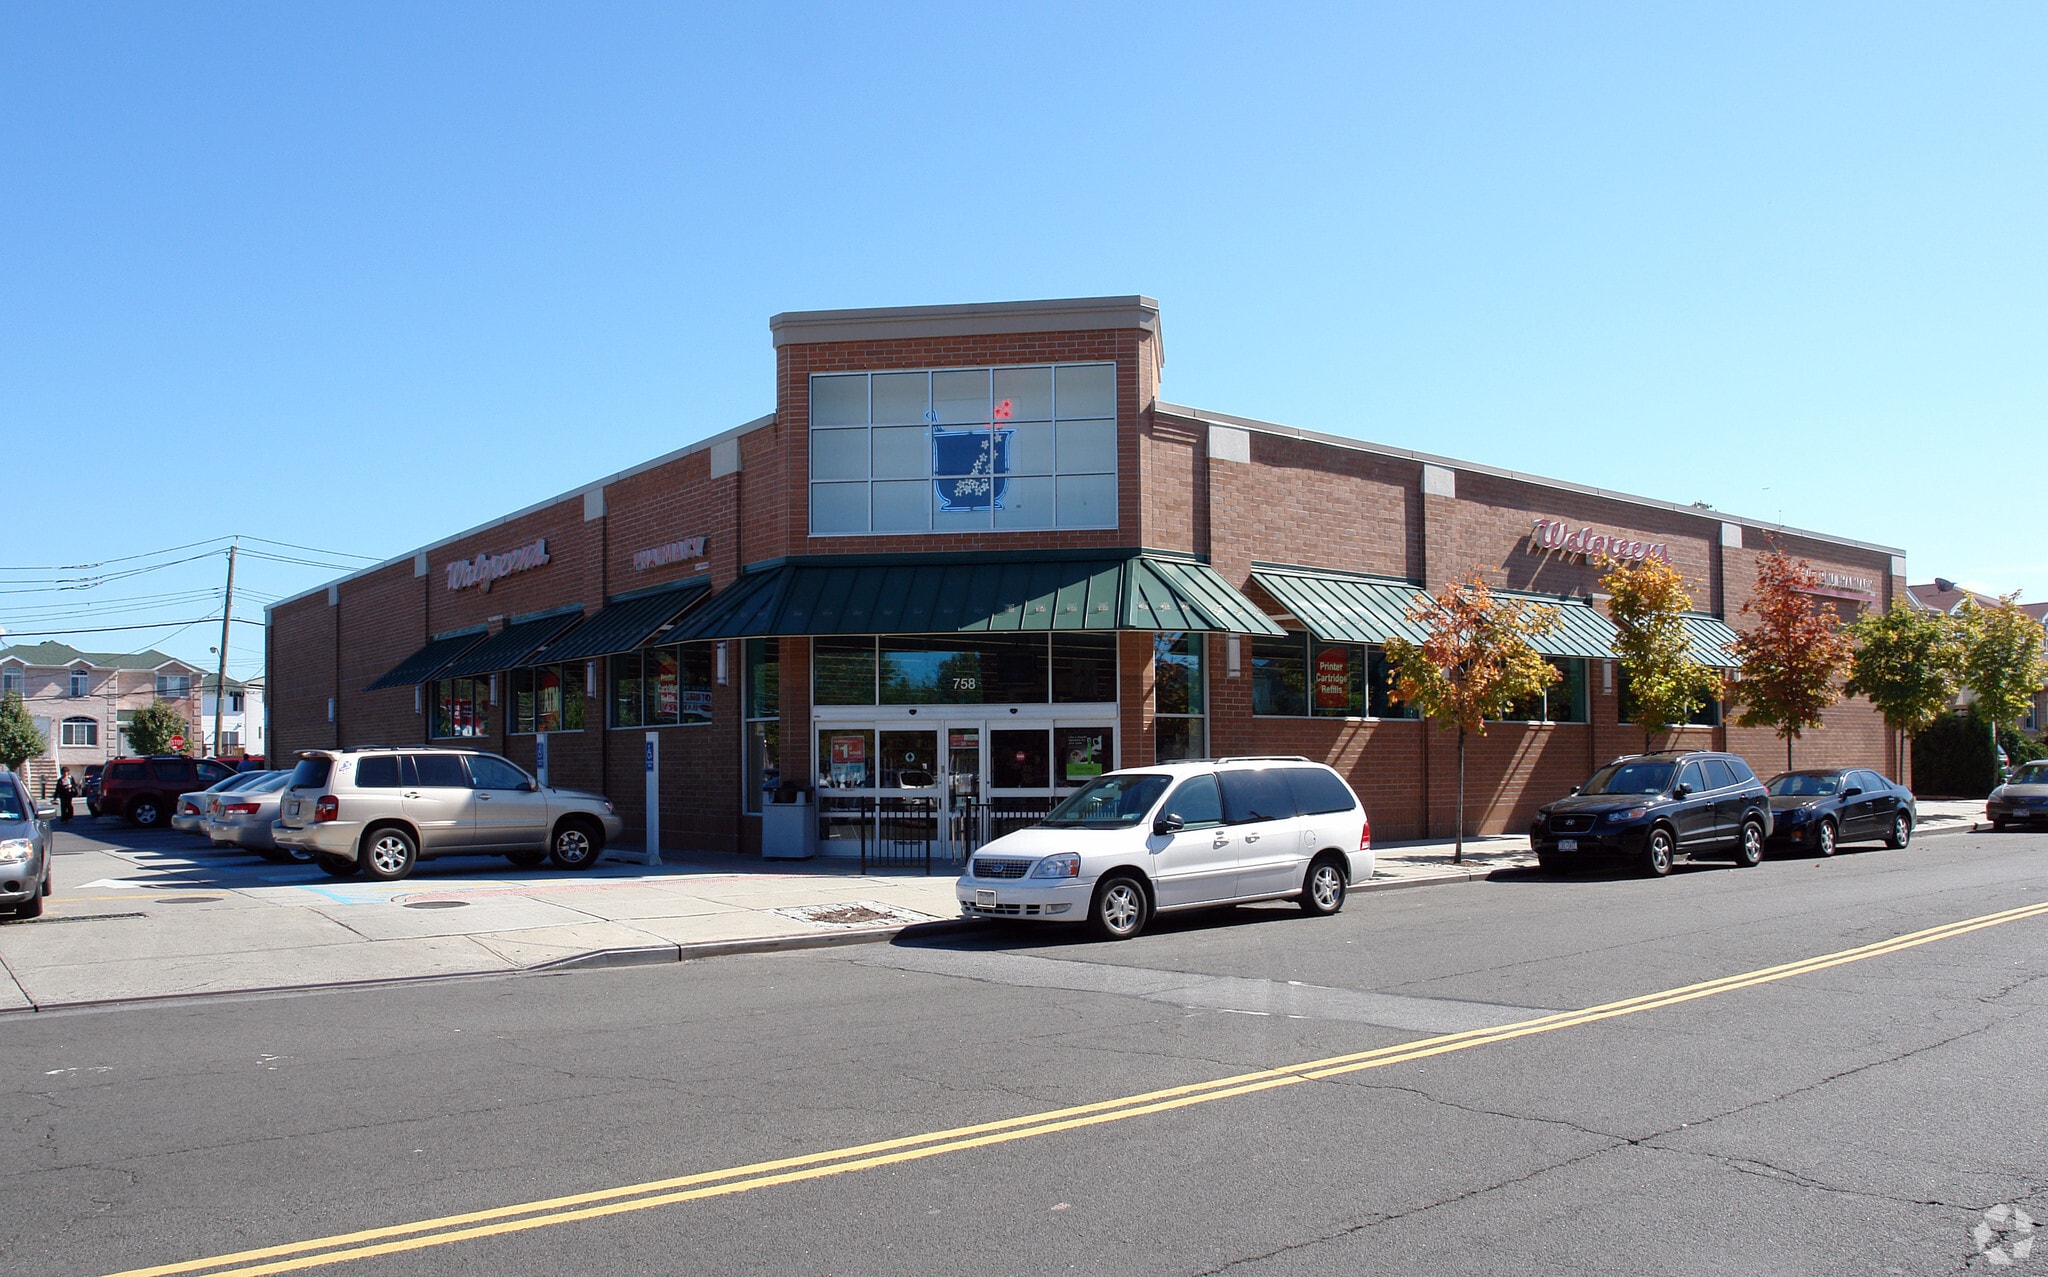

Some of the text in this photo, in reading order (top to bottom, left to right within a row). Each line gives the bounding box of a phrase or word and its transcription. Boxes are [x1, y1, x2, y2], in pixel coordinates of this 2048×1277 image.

[1533, 518, 1672, 565] Walgreens
[634, 536, 705, 571] PHARMACY
[446, 538, 550, 593] Walgreens
[1320, 661, 1343, 671] Printer
[953, 678, 976, 690] 758
[1315, 672, 1348, 685] Cartridge
[1321, 684, 1343, 694] Refills
